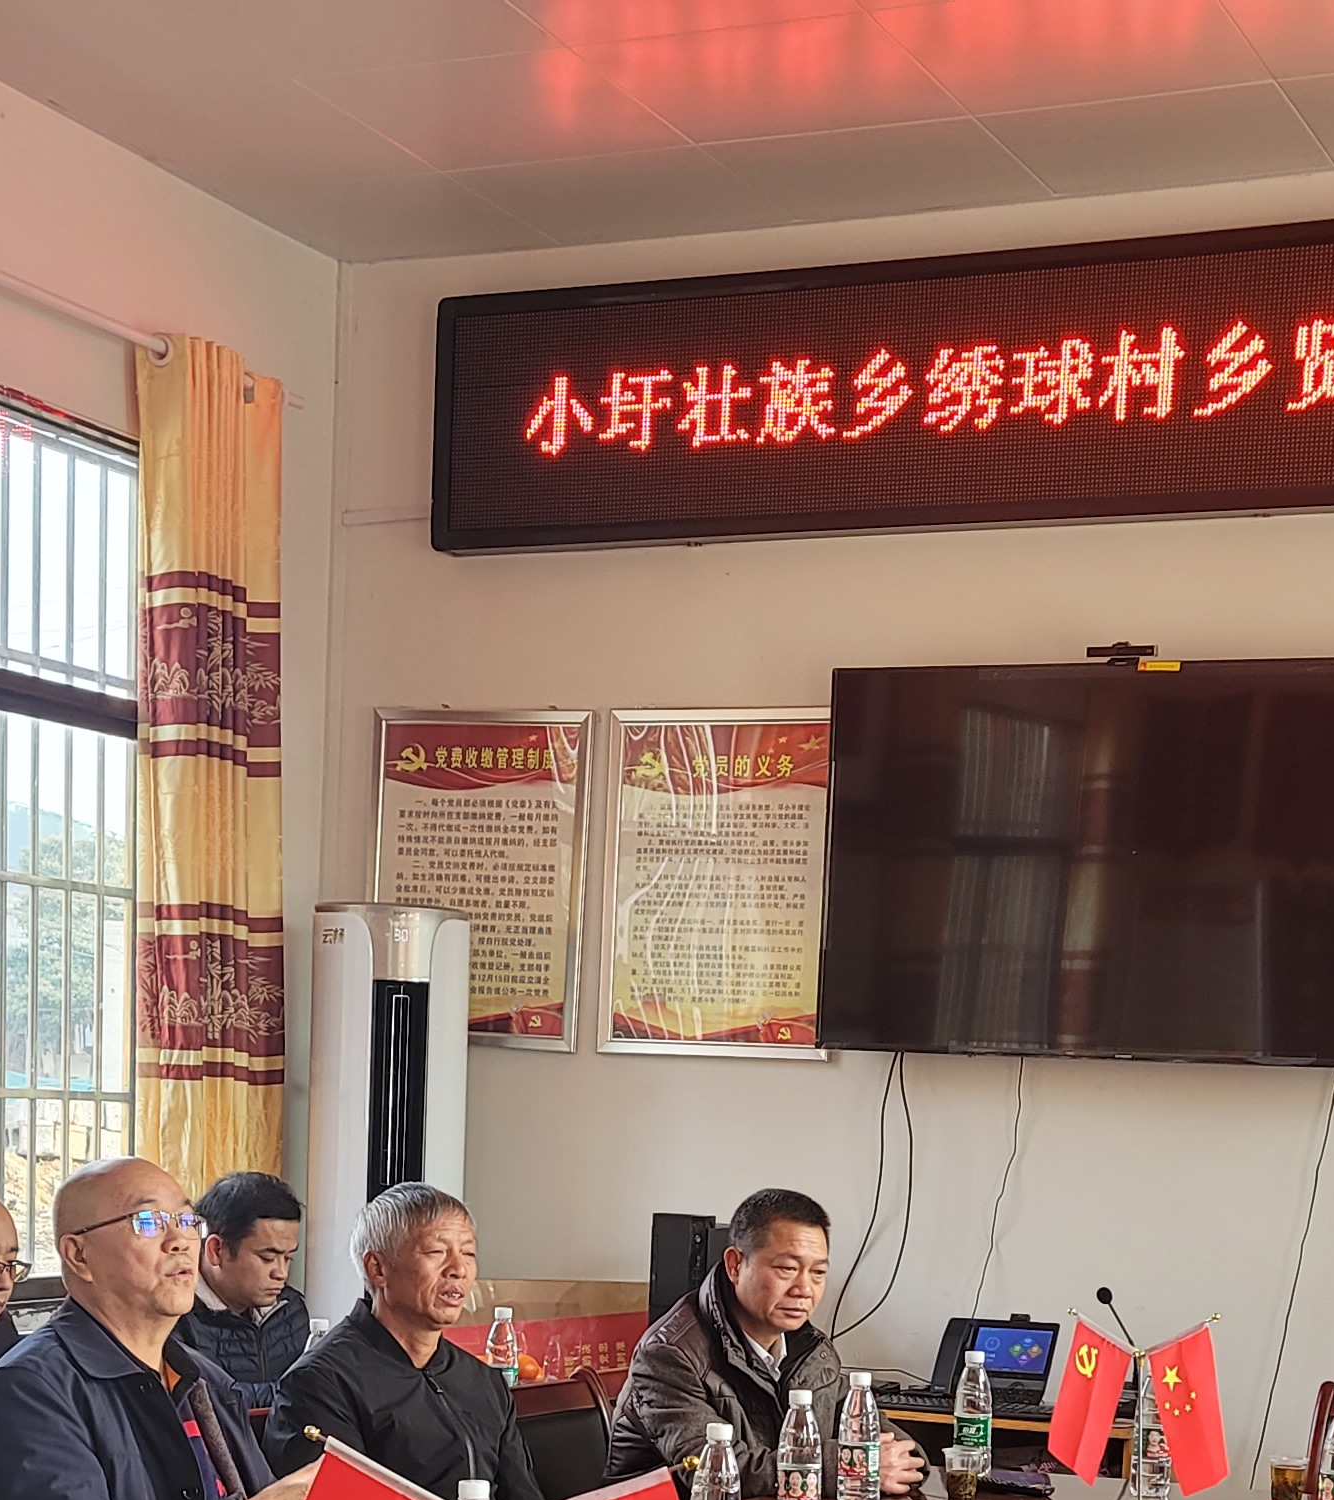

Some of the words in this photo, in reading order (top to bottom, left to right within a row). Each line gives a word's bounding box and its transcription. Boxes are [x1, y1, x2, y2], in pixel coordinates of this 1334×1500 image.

[435, 745, 554, 771] 党费收缴管理制度
[692, 756, 794, 778] 党员的义务
